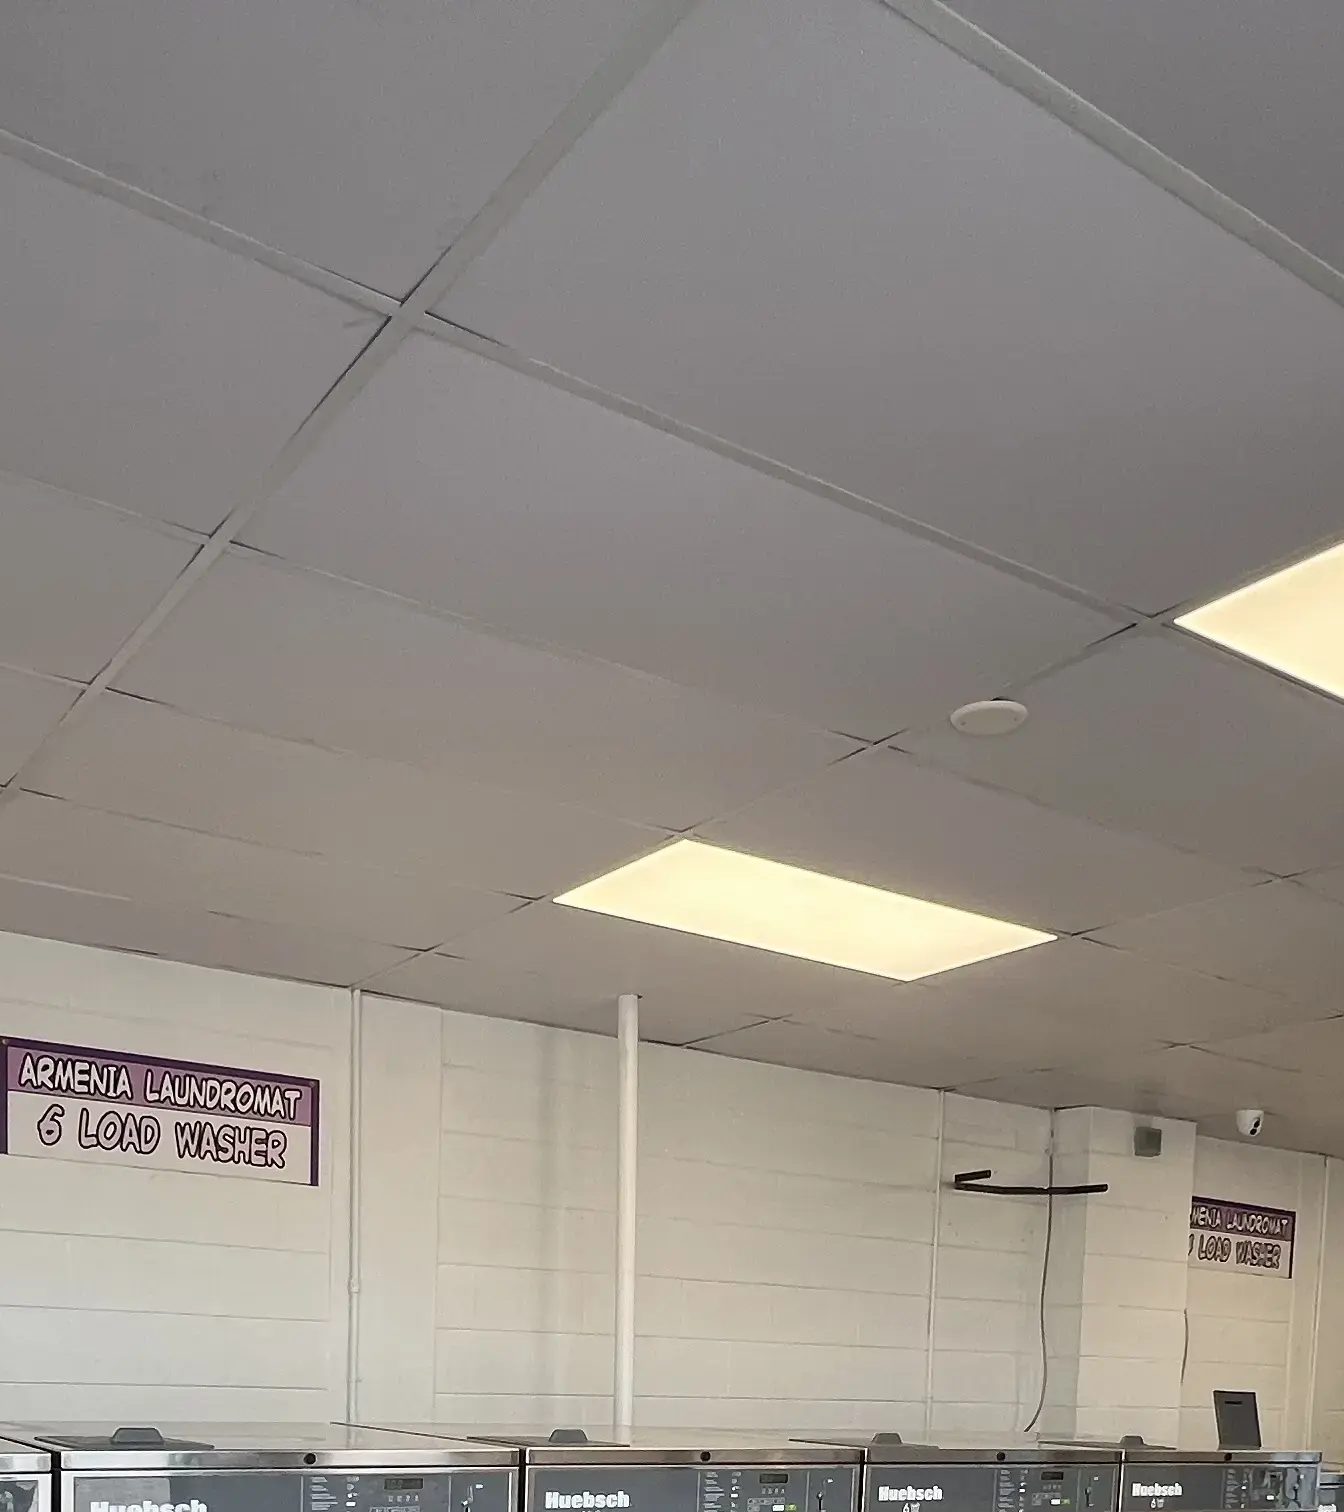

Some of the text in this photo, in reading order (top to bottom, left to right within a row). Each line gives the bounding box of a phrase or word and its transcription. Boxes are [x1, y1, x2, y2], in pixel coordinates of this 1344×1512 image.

[19, 1052, 302, 1120] ARMENIA LAUNDROMAT
[37, 1104, 287, 1169] 6 LOAD WASHER
[1198, 1234, 1231, 1262] LOAD
[545, 1490, 630, 1509] Huebsch
[878, 1485, 944, 1501] Huebsch
